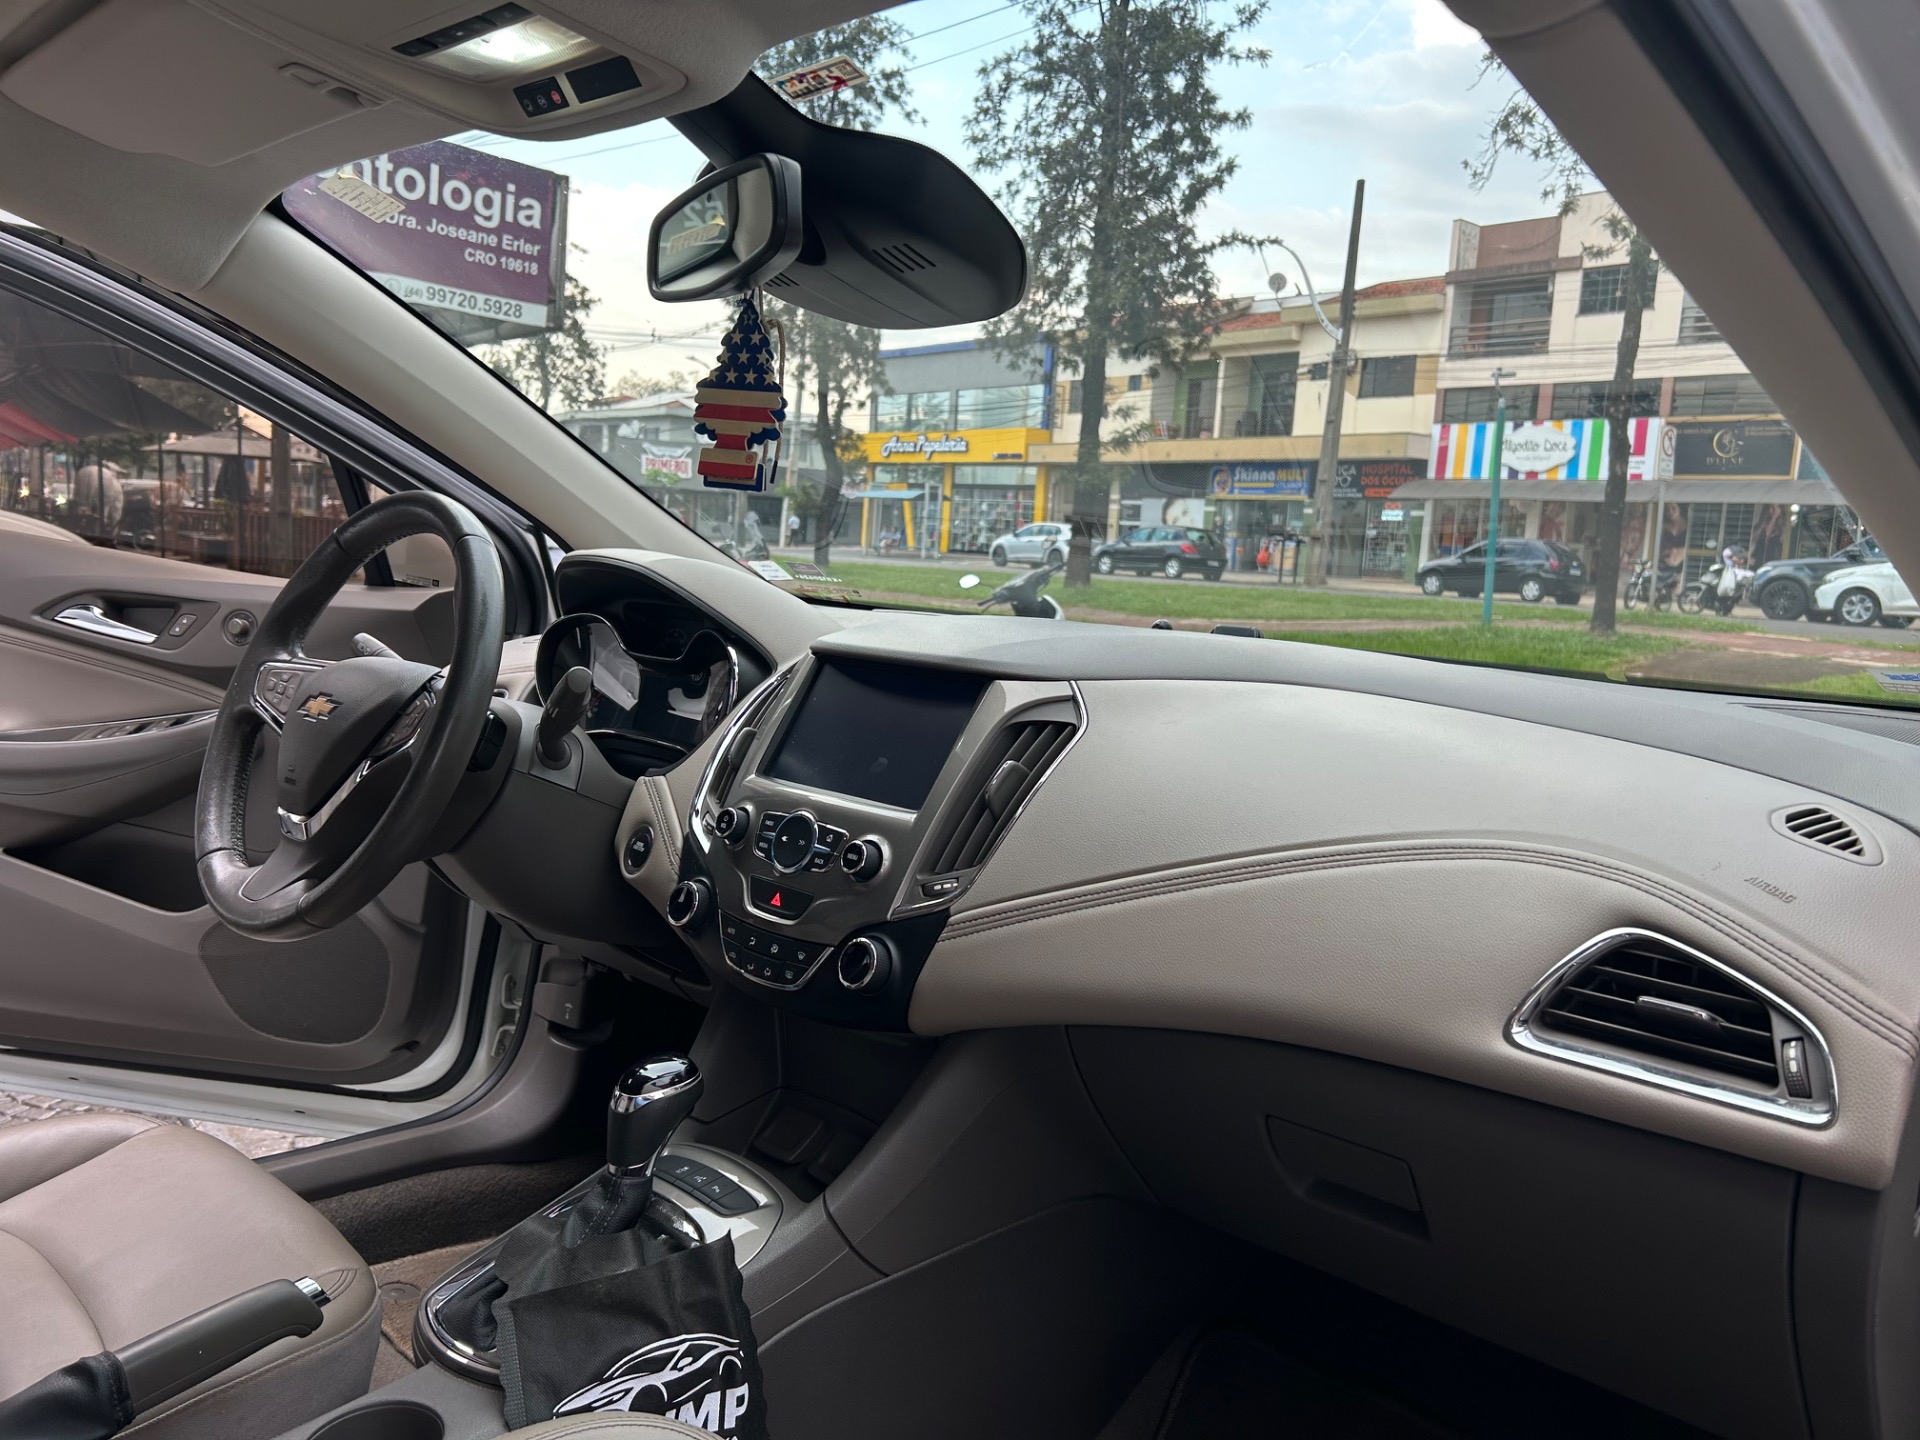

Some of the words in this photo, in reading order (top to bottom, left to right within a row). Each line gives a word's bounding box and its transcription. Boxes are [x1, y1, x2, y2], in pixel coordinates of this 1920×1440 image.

[426, 218, 498, 247] Joseane
[501, 234, 541, 256] Erler
[464, 247, 497, 267] CRO
[499, 256, 539, 276] 19618
[425, 285, 523, 319] 99720.5928
[1361, 463, 1414, 475] HOSPITAL
[1743, 876, 1797, 903] AIRBAG
